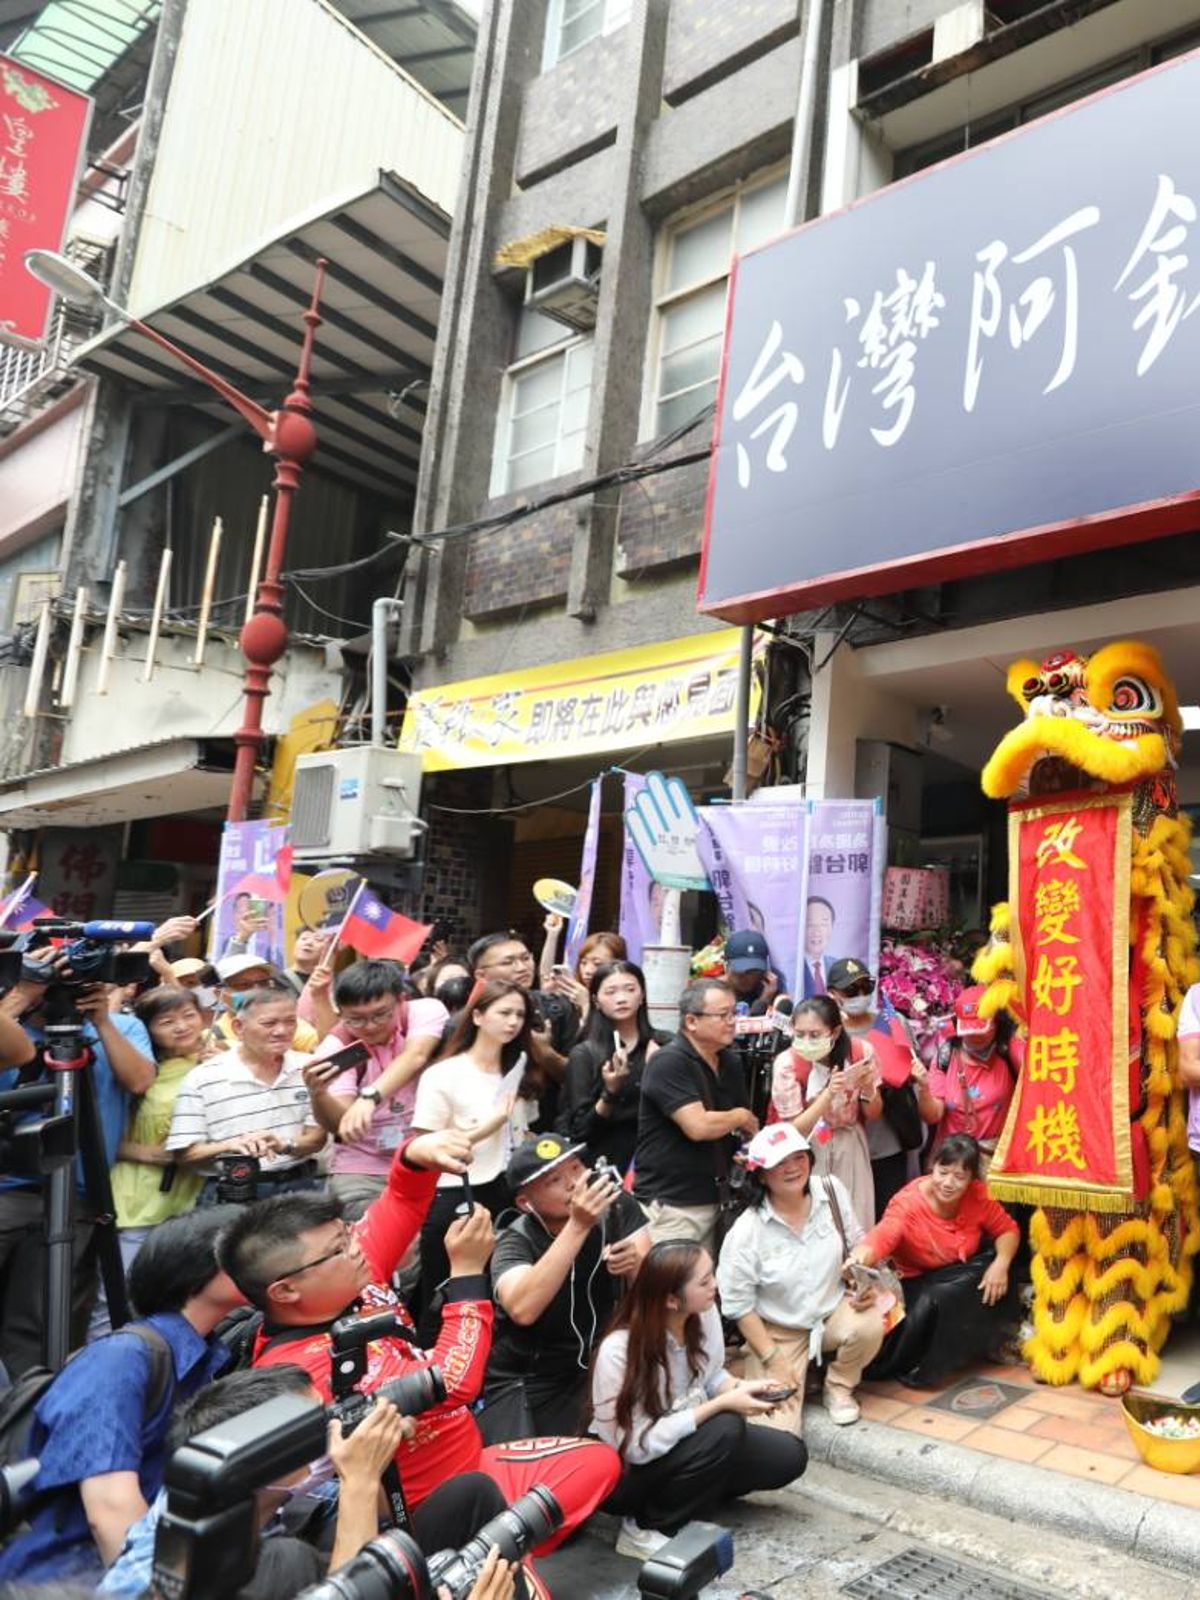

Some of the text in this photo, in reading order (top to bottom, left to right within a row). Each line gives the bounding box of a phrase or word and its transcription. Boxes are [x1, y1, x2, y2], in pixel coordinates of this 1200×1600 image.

[1026, 816, 1087, 1171] 改變好時機
